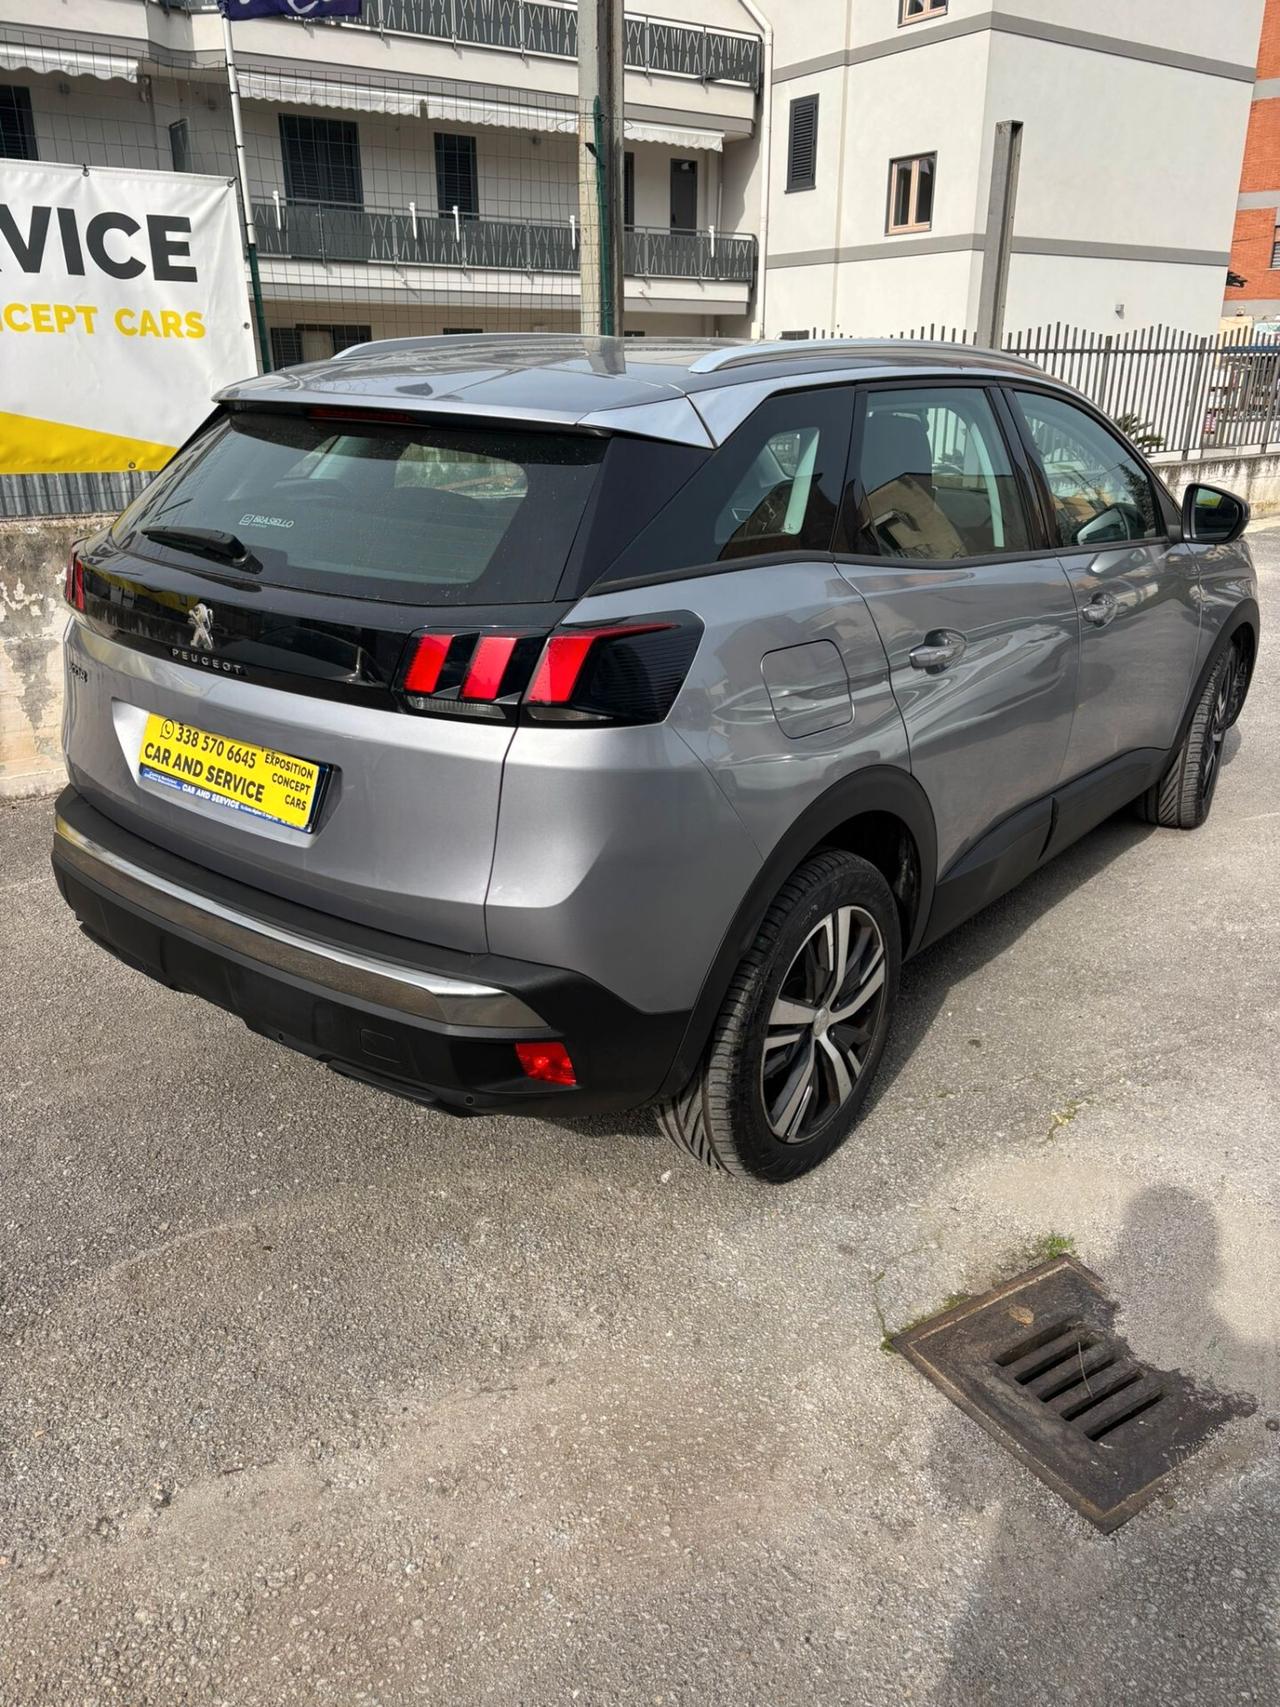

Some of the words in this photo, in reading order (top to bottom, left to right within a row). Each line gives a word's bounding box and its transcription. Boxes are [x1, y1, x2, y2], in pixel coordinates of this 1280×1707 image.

[0, 204, 198, 283] VICE
[0, 303, 98, 334] CEPT
[114, 308, 206, 338] CARS
[172, 648, 243, 674] PEUGEOT
[176, 724, 200, 748] 338
[201, 735, 225, 757] 570
[226, 745, 257, 769] 6645
[145, 742, 171, 767] CAR
[173, 752, 203, 777] AND
[206, 766, 265, 803] SERVICE
[264, 752, 314, 780] EXPOSITION
[182, 784, 196, 796] CAR
[195, 789, 211, 800] AND
[211, 793, 240, 810] SERVICE
[272, 772, 311, 796] CONCEPT
[285, 794, 307, 811] CARS
